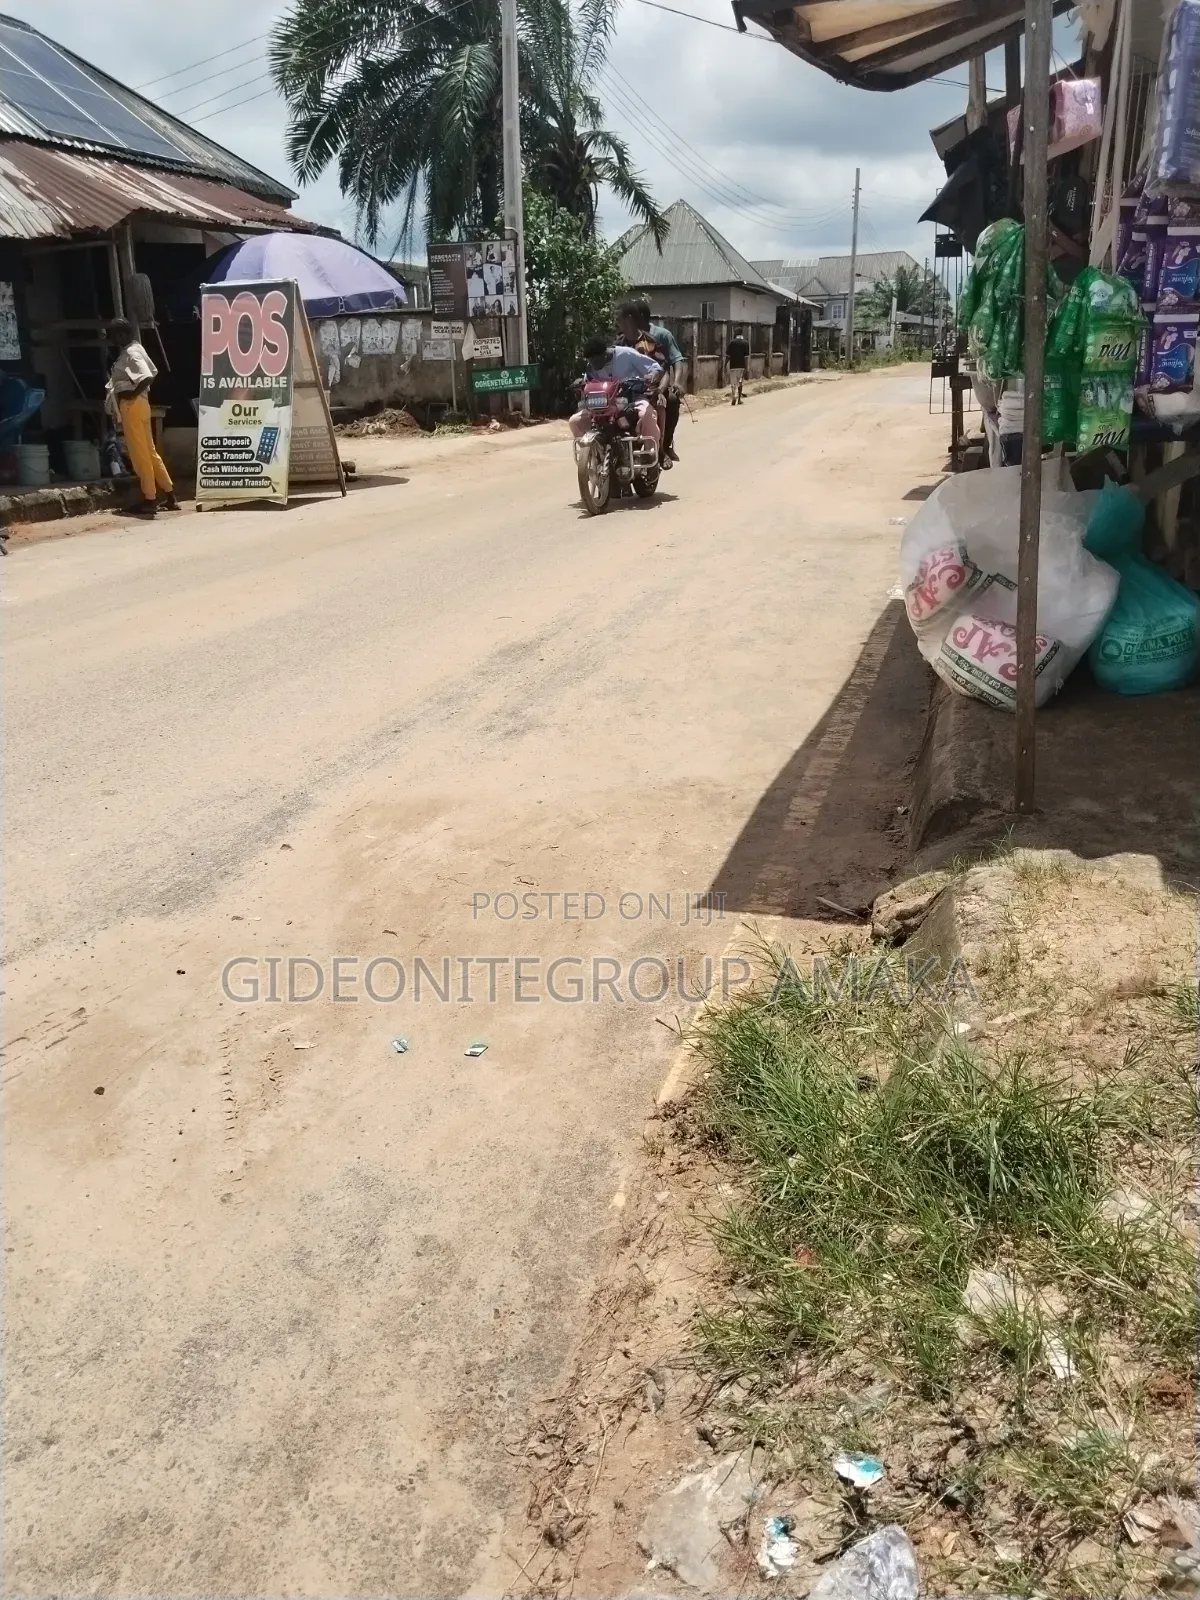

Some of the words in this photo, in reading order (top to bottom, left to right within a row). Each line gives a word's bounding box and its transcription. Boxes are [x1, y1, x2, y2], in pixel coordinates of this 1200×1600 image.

[201, 291, 289, 376] POS
[203, 377, 215, 389] IS
[219, 376, 287, 389] AVAILABLE
[231, 403, 259, 417] Our
[228, 418, 262, 426] Services
[202, 437, 220, 446] Cash
[222, 437, 250, 447] Deposit
[202, 452, 220, 460] Cash
[223, 452, 253, 460] Transfer
[201, 465, 219, 473] Cash
[221, 465, 261, 473] Withdrawal
[201, 479, 231, 487] Withdraw
[244, 478, 271, 486] Transfer
